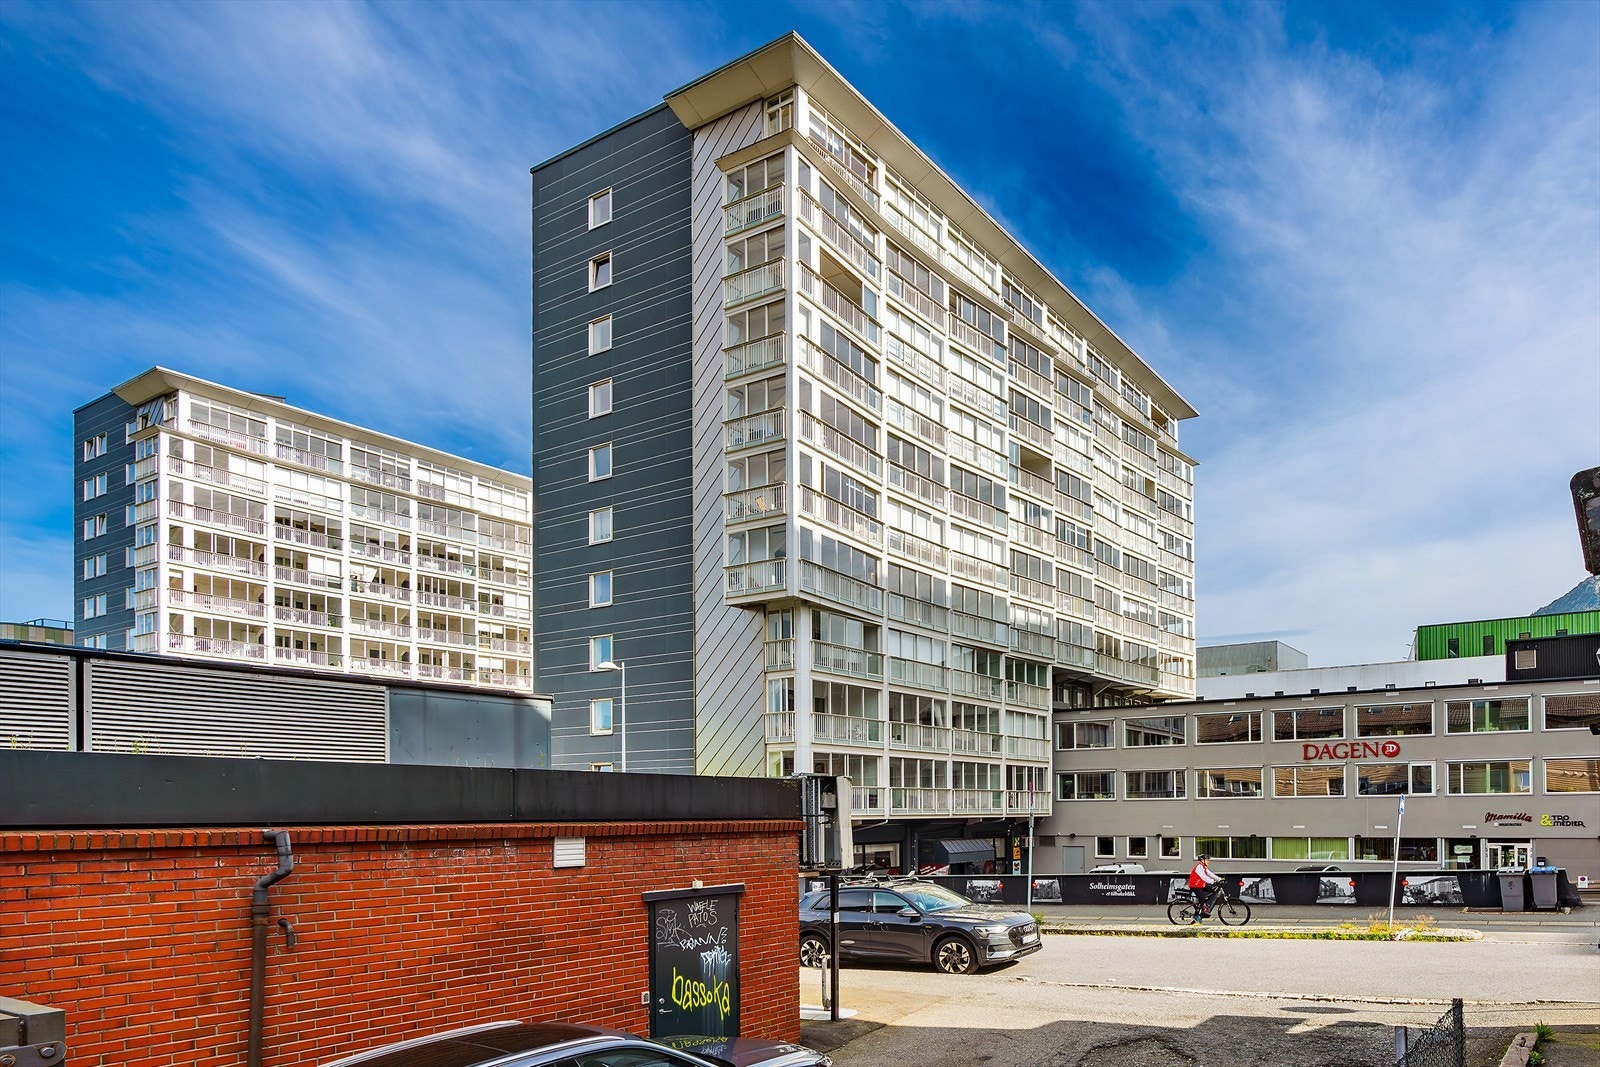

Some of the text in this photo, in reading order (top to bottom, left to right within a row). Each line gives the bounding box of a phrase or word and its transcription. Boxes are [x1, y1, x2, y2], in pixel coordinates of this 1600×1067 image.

[1303, 741, 1379, 760] DAGEN
[1485, 812, 1533, 823] Mamilla
[1089, 882, 1136, 892] Solheimsgaten
